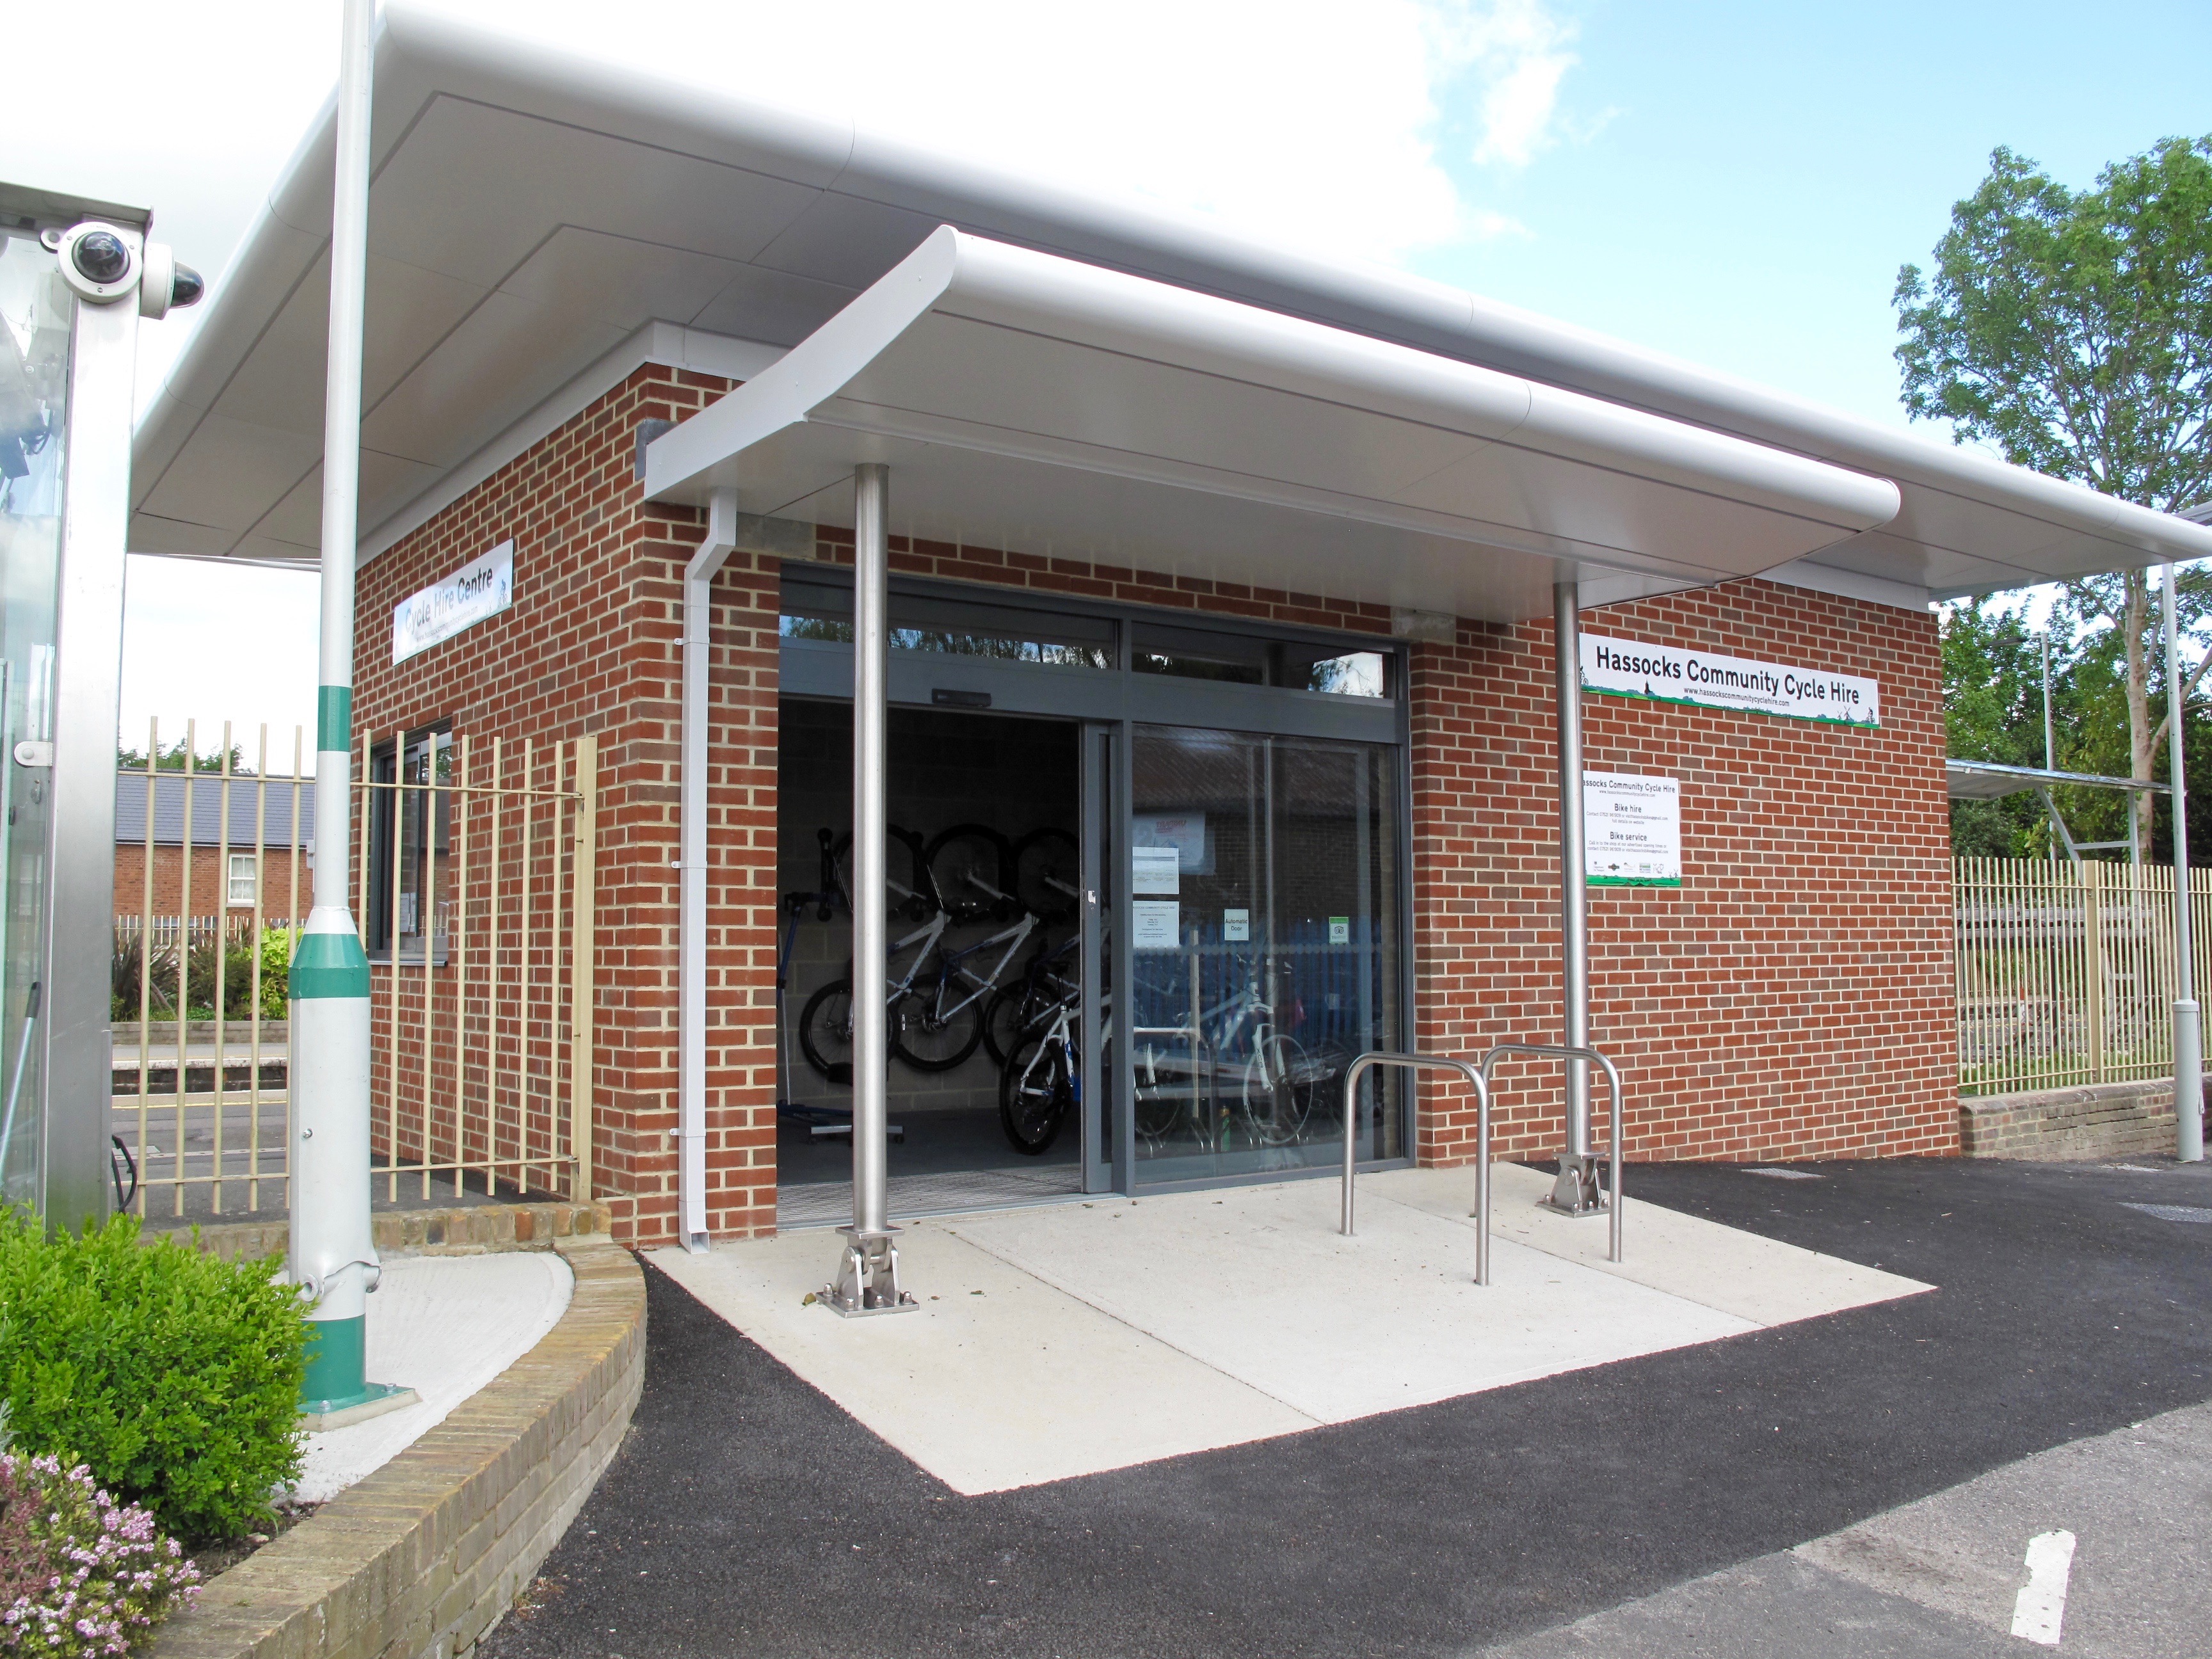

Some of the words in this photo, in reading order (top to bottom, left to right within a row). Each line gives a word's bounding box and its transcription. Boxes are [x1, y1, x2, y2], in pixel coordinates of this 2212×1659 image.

[405, 598, 431, 635] Cycle
[434, 589, 454, 618] Hire
[458, 567, 493, 604] Centre
[1596, 646, 1681, 679] Hassocks
[1687, 659, 1779, 696] Community
[1784, 674, 1825, 700] Cycle
[1831, 681, 1859, 704] Hire
[1683, 687, 1790, 707] www.hassockscommunitycyclehire.com
[1583, 780, 1607, 788] assocks
[1609, 780, 1643, 792] Community
[1645, 783, 1662, 793] Cycle
[1663, 785, 1675, 794] Hire
[1614, 803, 1628, 812] Bike
[1630, 805, 1642, 813] hire
[1610, 831, 1624, 840] Bike
[1625, 833, 1647, 842] service
